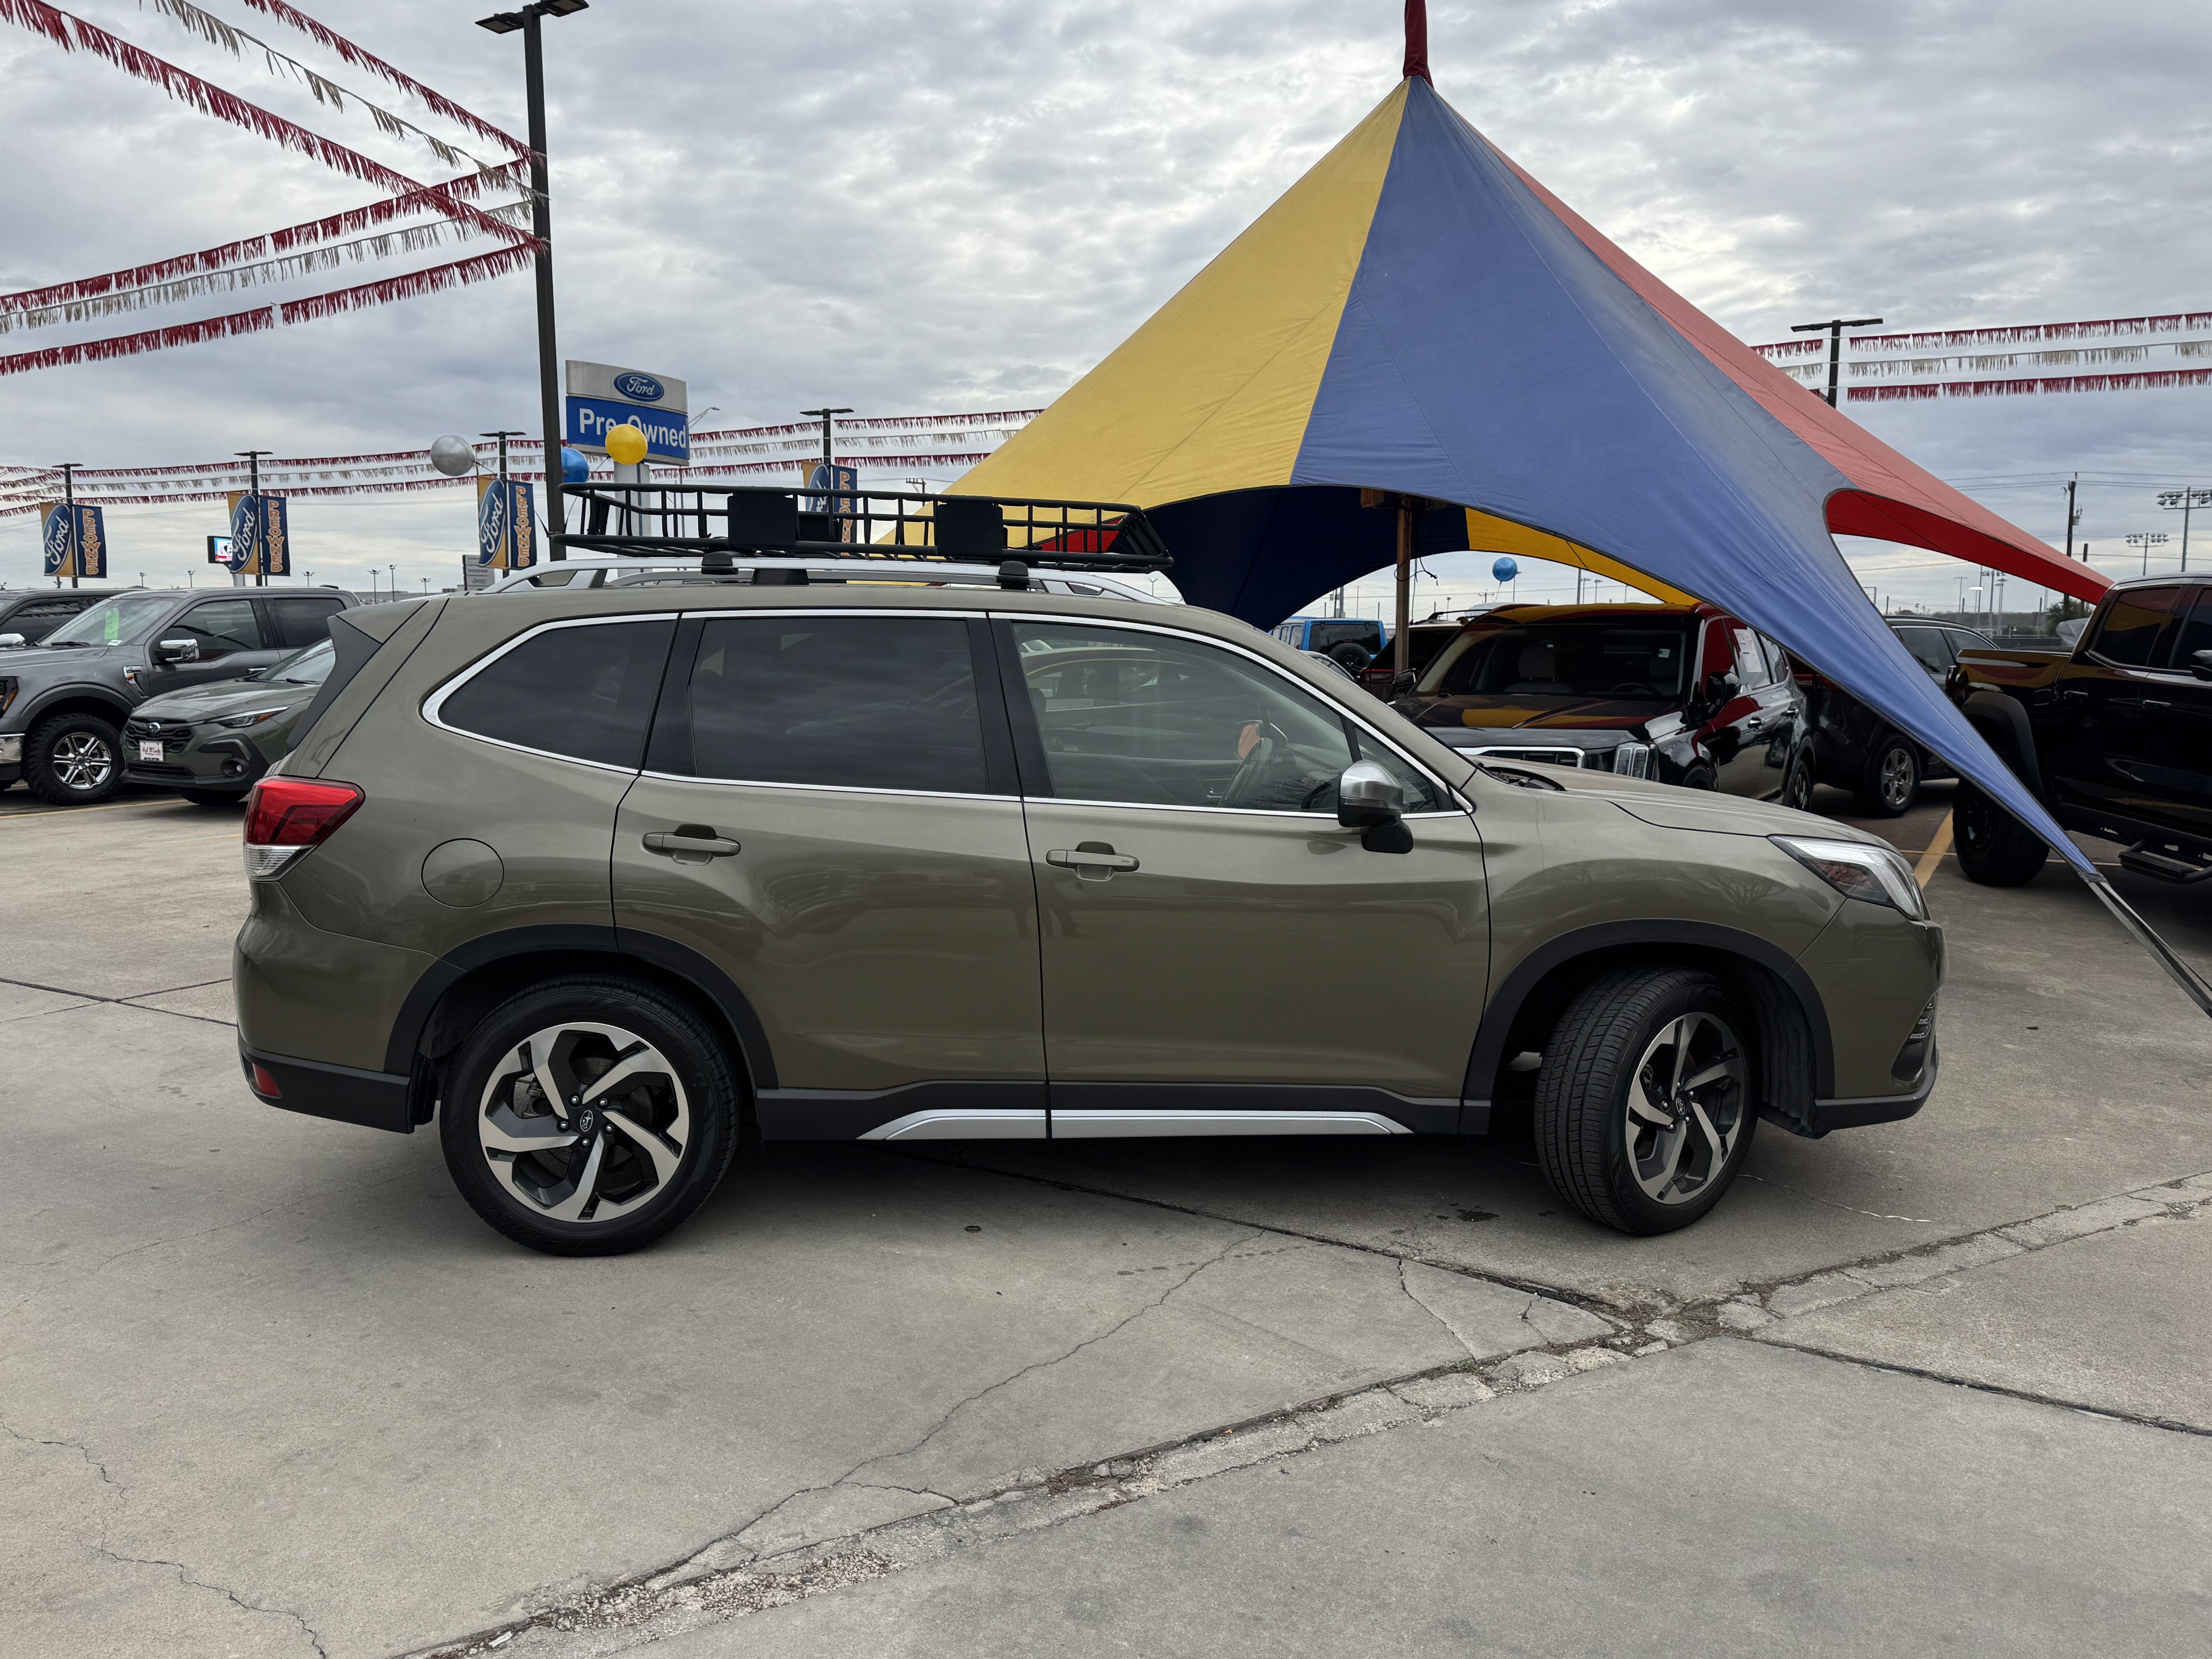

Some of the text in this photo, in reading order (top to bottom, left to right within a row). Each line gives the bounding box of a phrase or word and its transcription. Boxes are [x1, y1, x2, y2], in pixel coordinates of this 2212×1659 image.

[627, 376, 655, 396] Ford
[580, 408, 686, 448] PreOwned
[44, 515, 69, 565] Ford
[80, 508, 101, 575] PREOWNED
[232, 507, 255, 561] Ford
[266, 500, 285, 572] PREOWNED
[481, 492, 503, 553] Ford
[514, 486, 532, 567] PREOWNED
